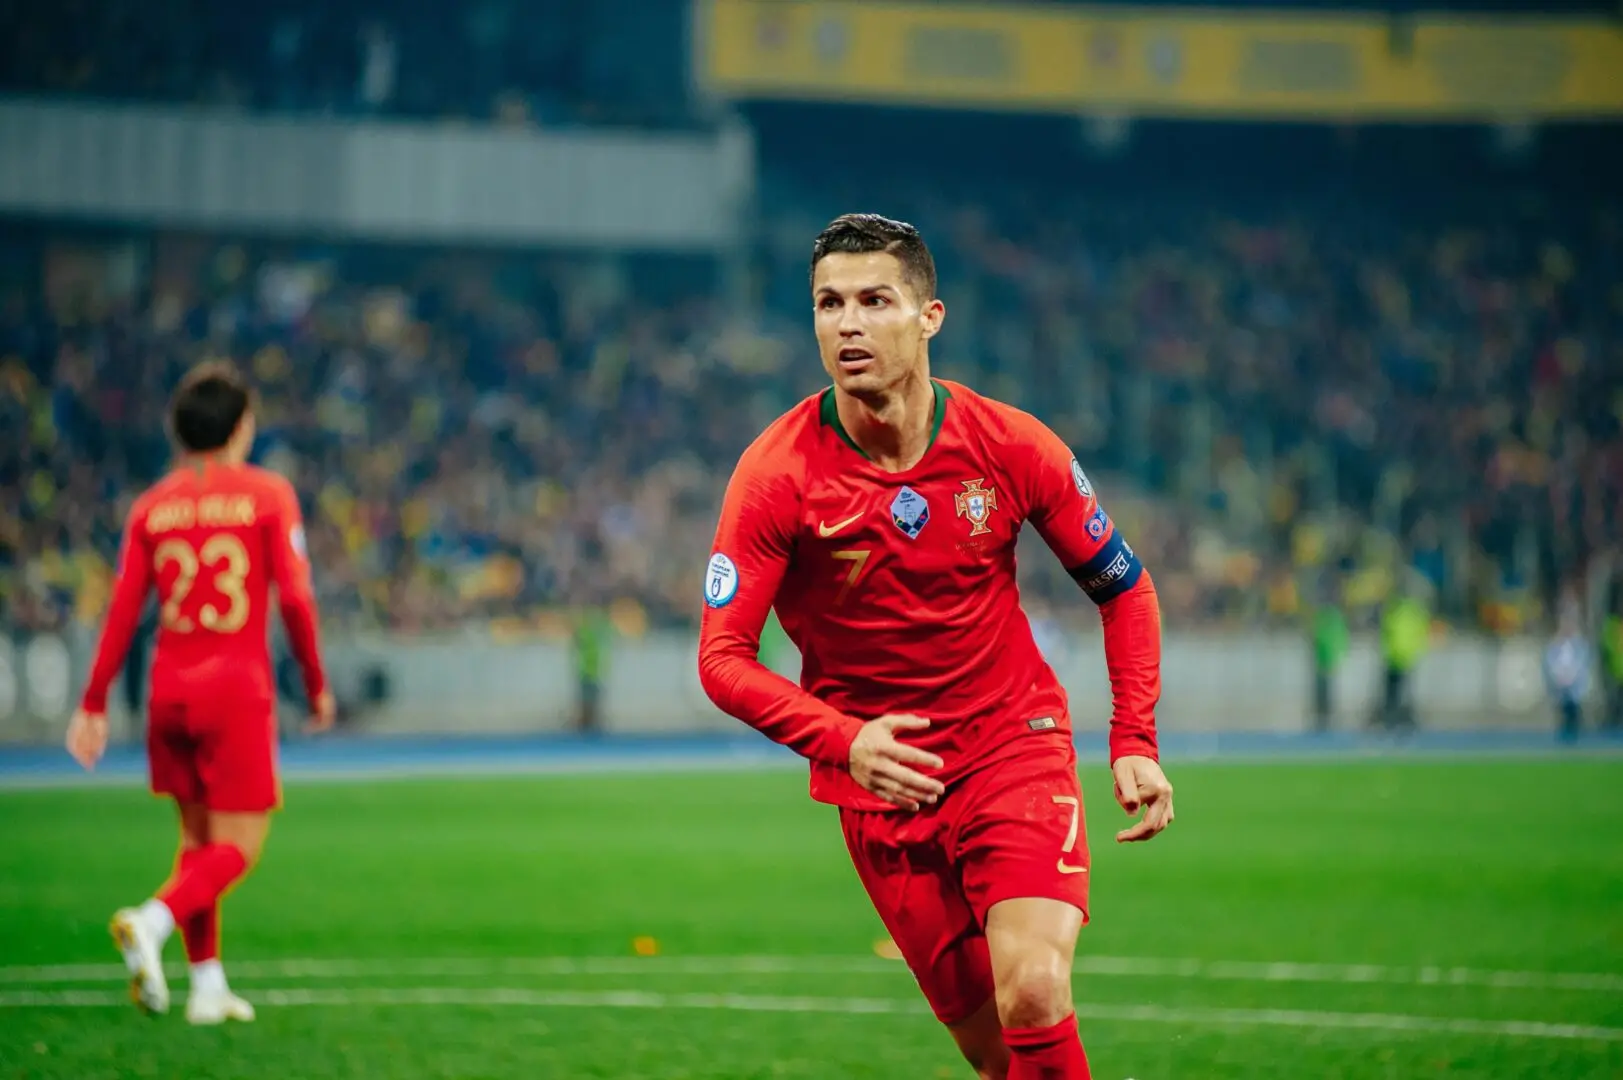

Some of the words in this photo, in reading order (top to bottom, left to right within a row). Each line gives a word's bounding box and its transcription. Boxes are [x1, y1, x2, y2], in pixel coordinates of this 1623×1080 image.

[155, 534, 250, 633] 23
[831, 550, 871, 606] 7
[1089, 554, 1128, 588] RESPECT
[1051, 796, 1079, 853] 7
